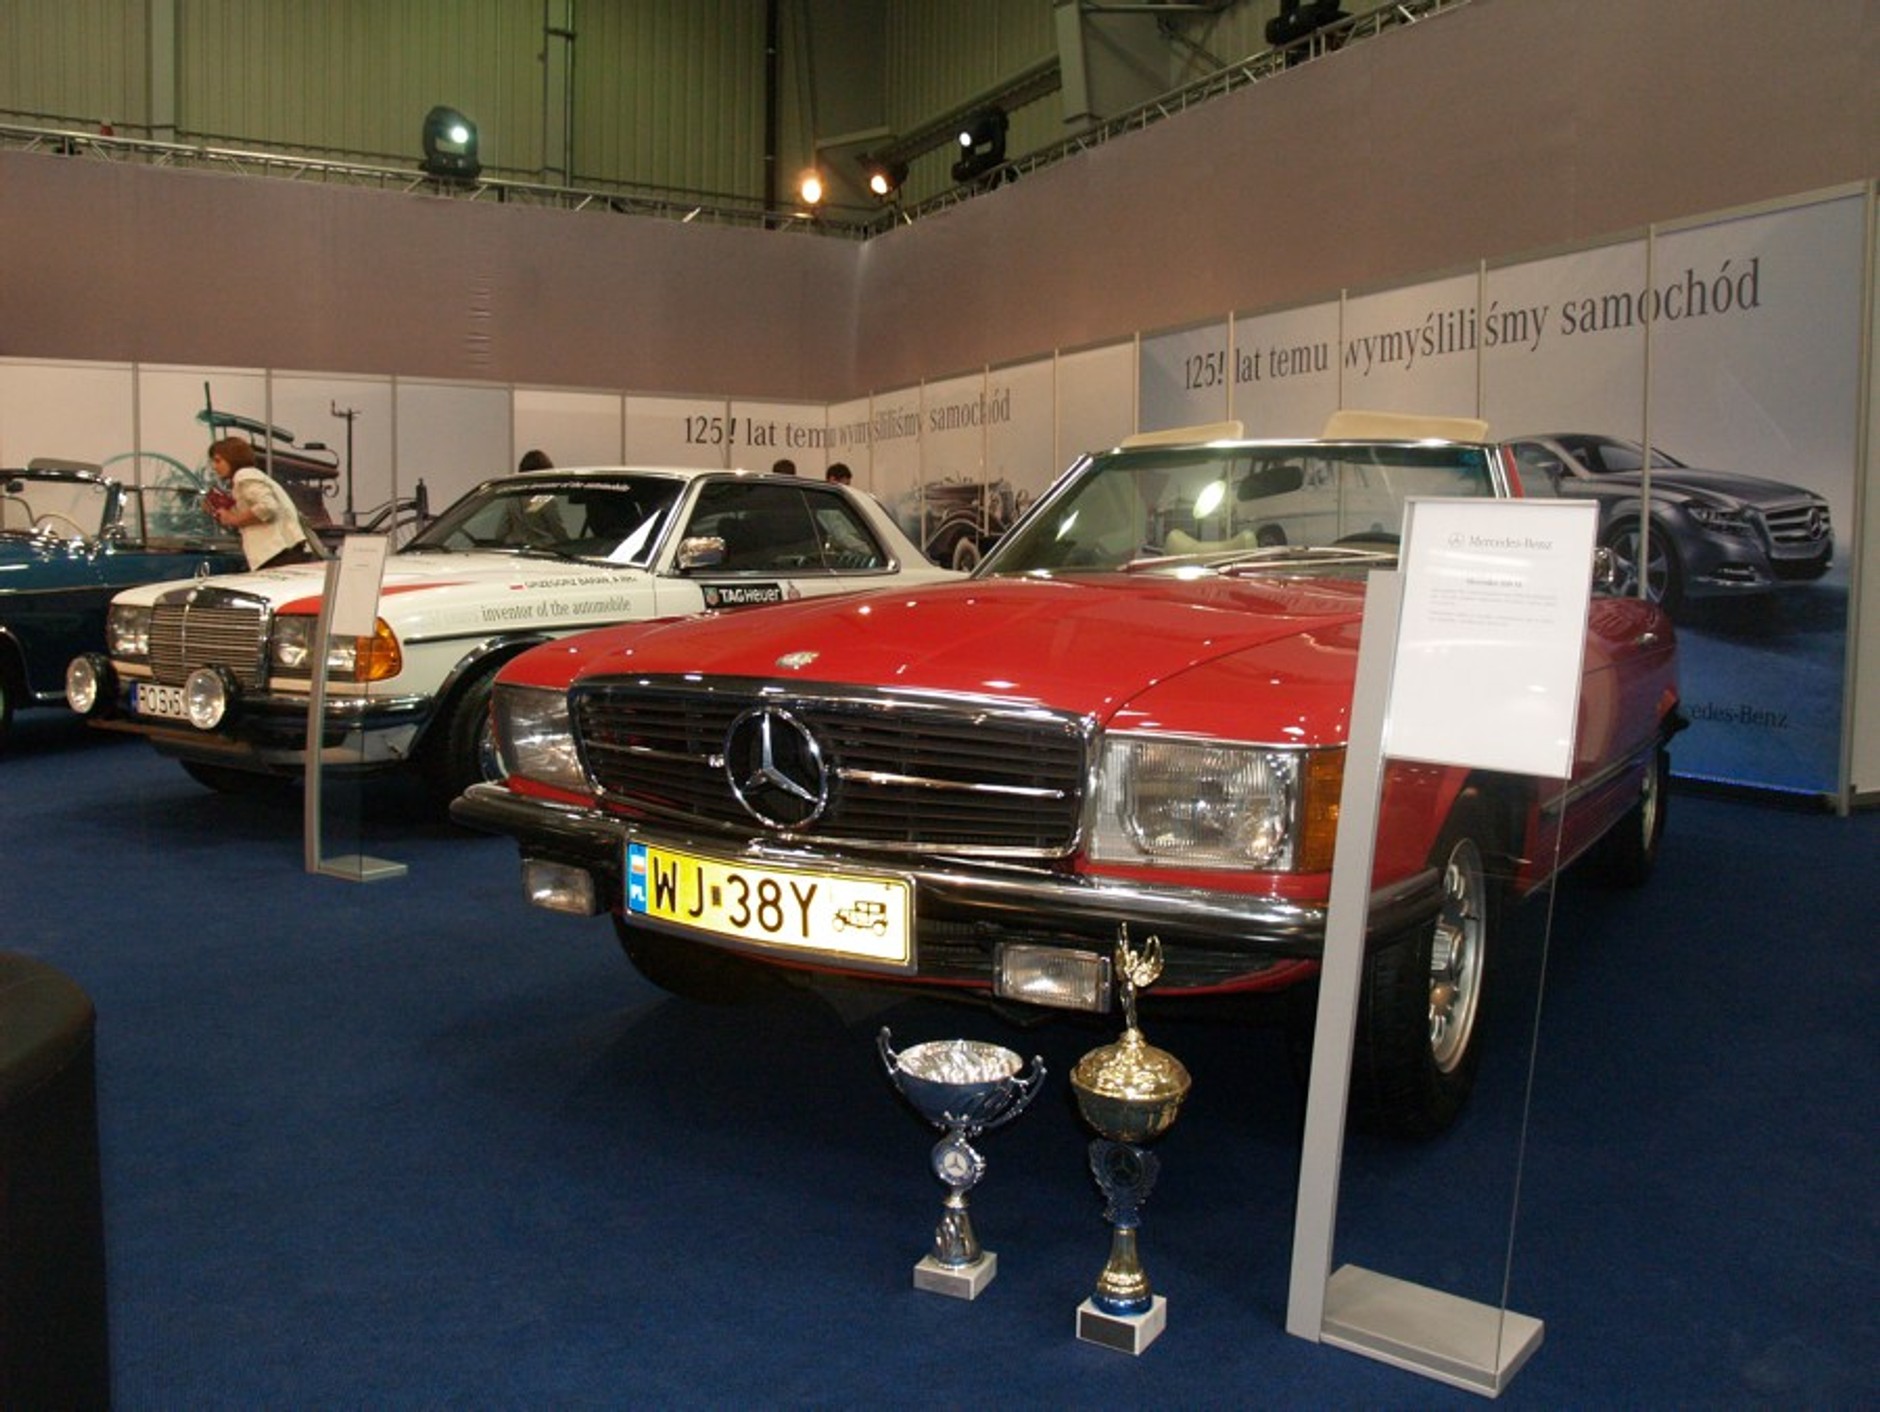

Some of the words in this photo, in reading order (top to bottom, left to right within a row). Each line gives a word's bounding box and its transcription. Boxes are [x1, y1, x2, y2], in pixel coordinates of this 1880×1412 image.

[1185, 350, 1225, 390] 125!
[1235, 347, 1262, 384] lat
[1269, 342, 1329, 378] temu
[1561, 256, 1761, 337] samochód
[683, 415, 737, 446] 125!
[745, 417, 777, 447] lat
[481, 604, 534, 622] inventor
[536, 600, 549, 618] of
[550, 598, 570, 616] the
[572, 595, 631, 614] automobile
[726, 874, 818, 938] 38Y
